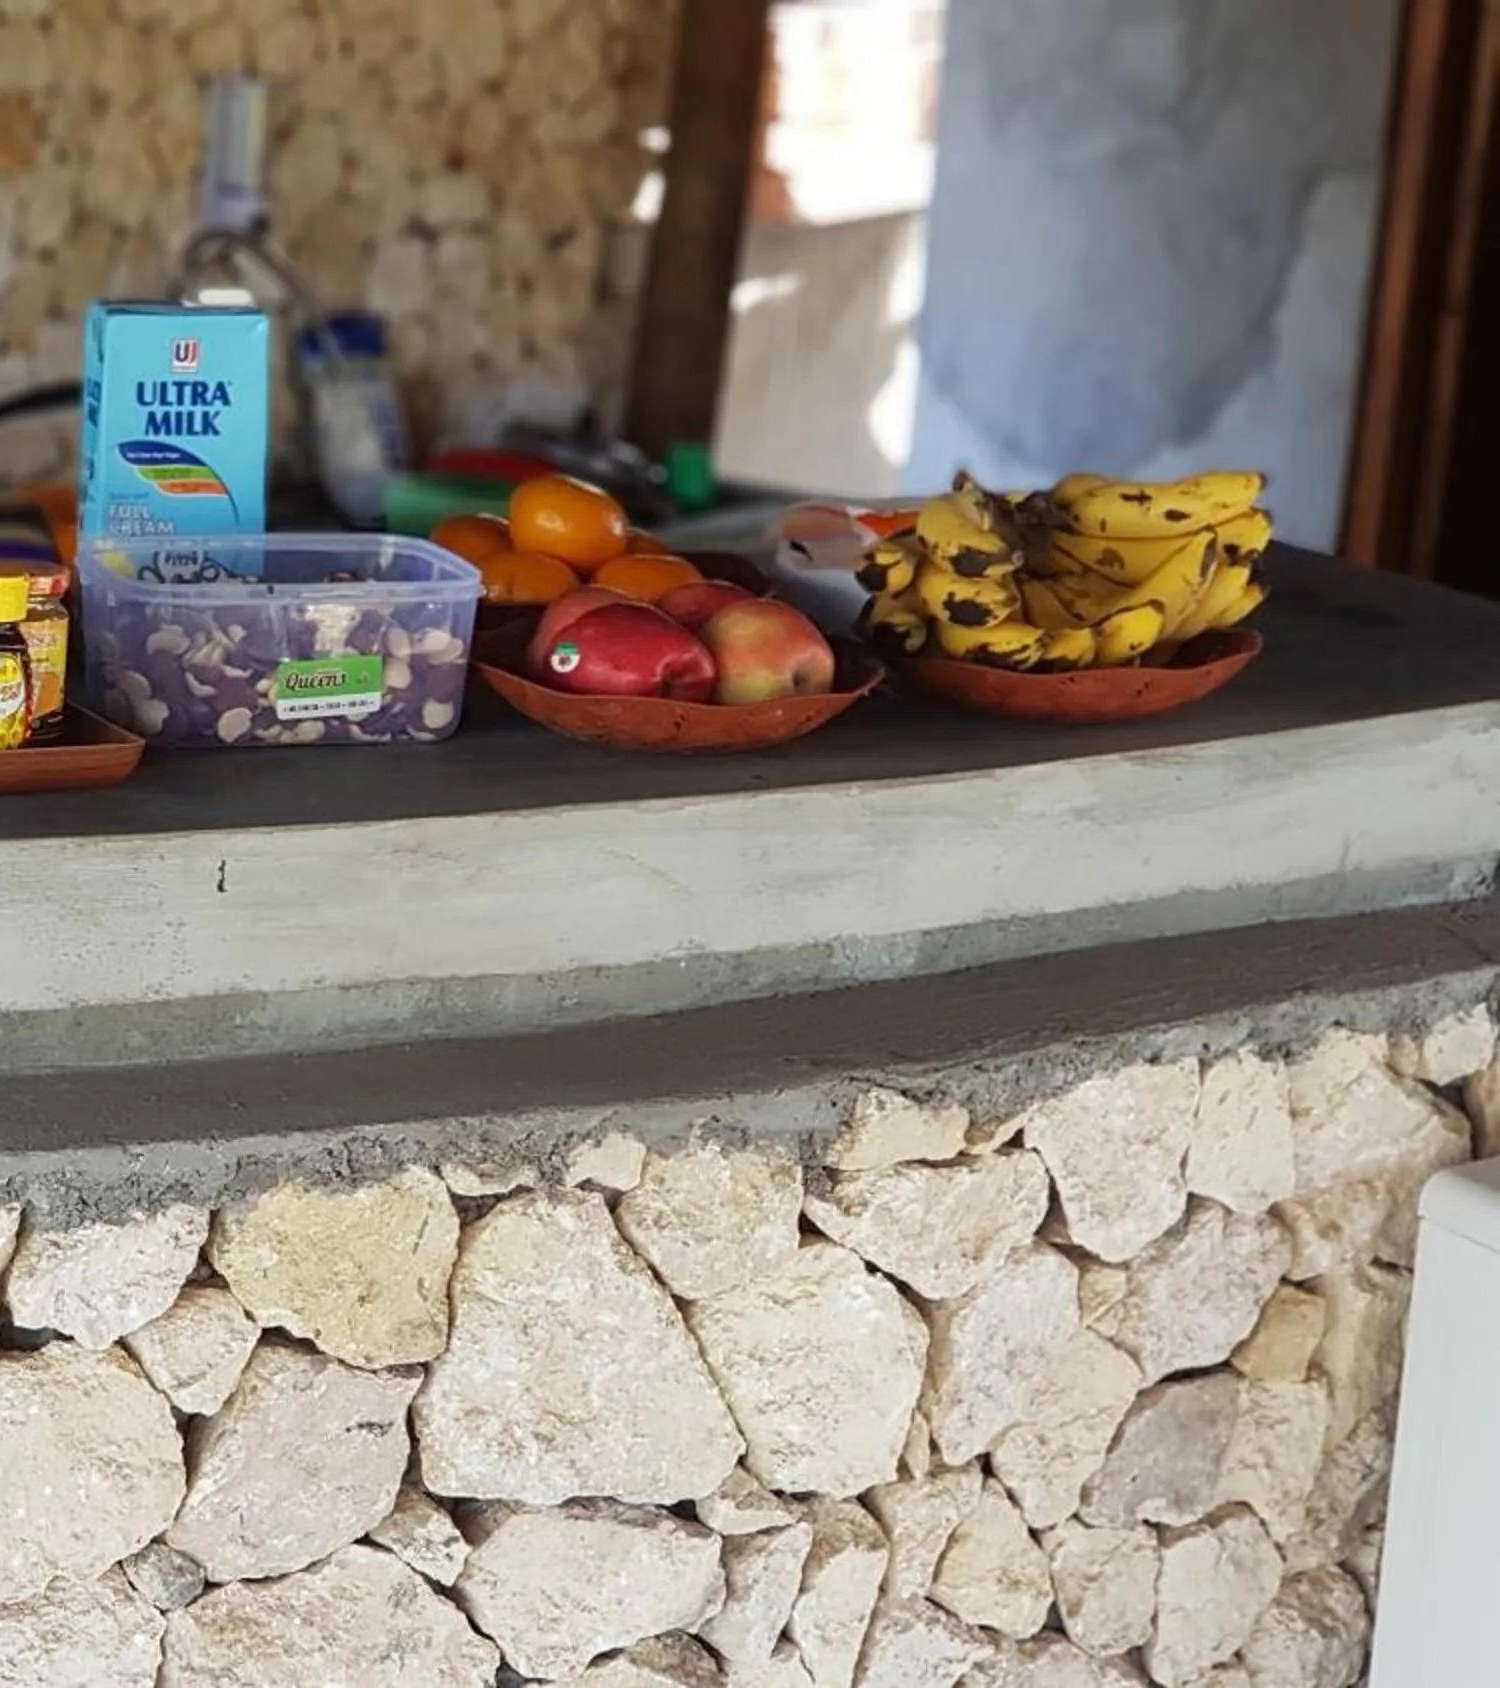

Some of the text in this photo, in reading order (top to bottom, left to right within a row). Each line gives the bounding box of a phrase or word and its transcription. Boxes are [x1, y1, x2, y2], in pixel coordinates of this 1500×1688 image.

[136, 381, 231, 407] ULTRA
[145, 410, 221, 437] MILK
[108, 504, 150, 519] FULL
[108, 518, 175, 536] CREAM
